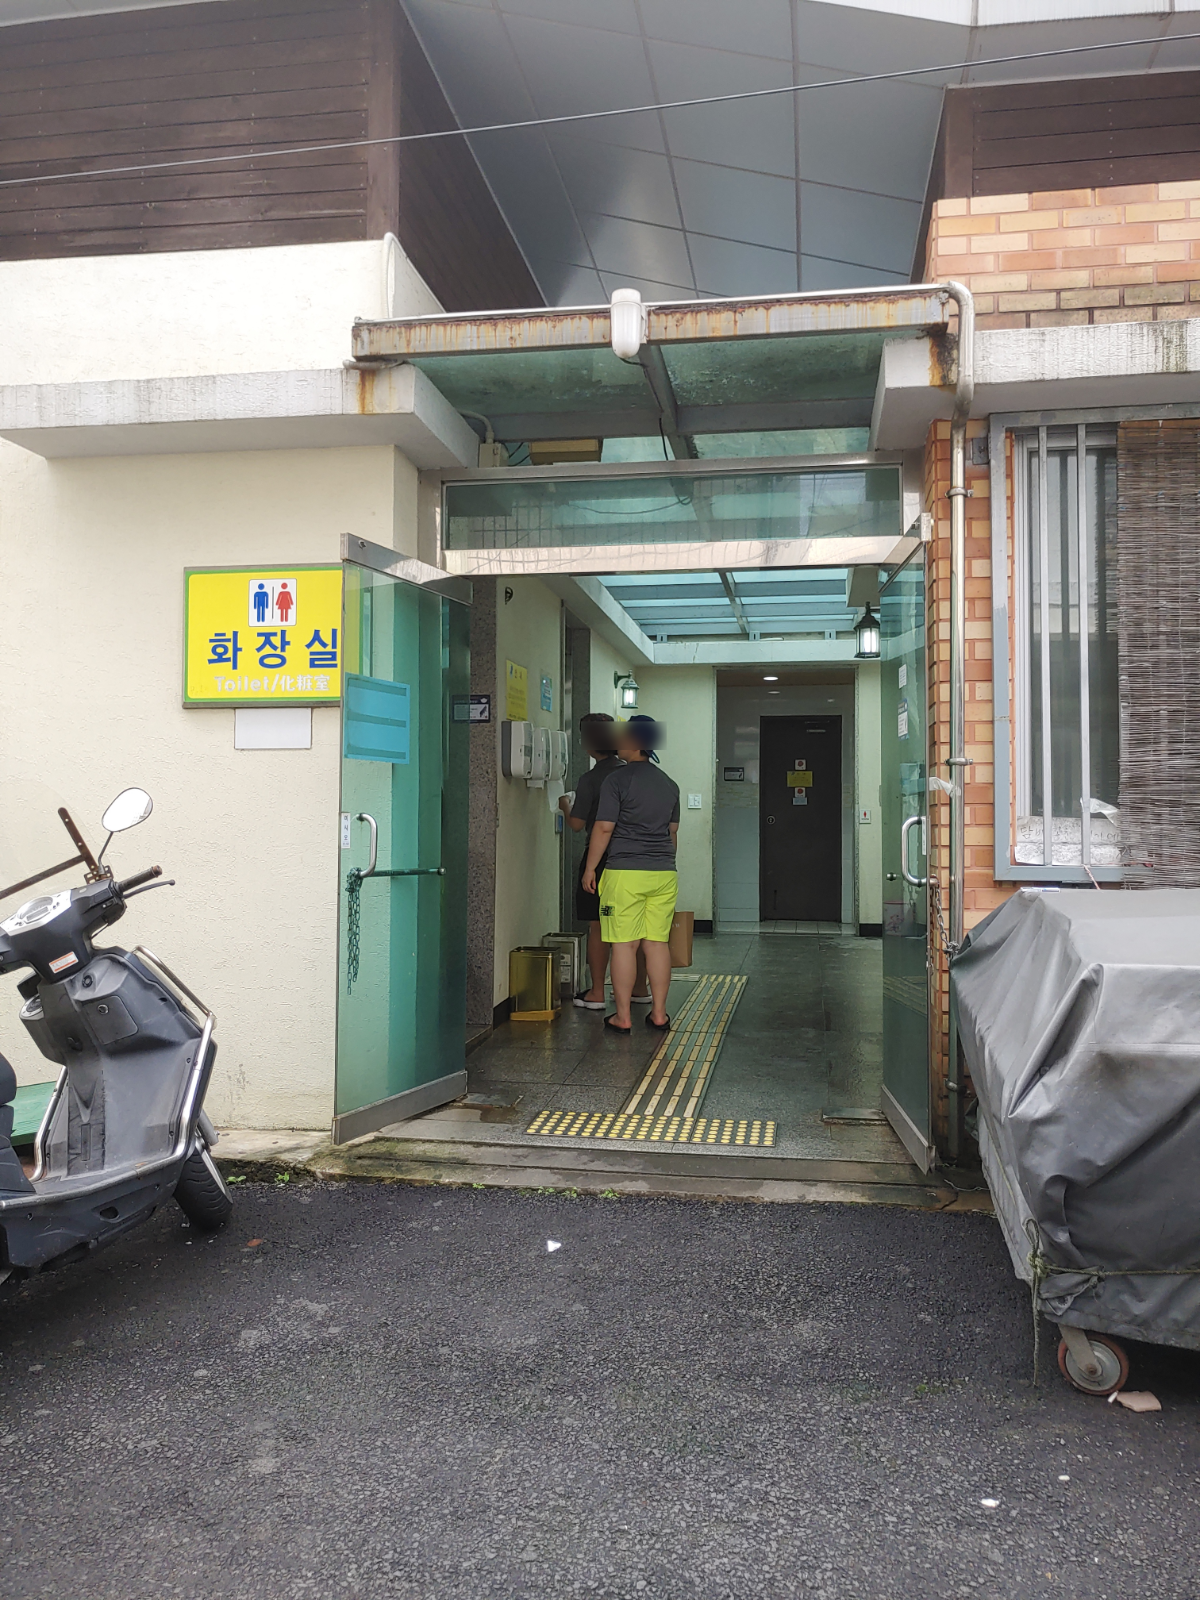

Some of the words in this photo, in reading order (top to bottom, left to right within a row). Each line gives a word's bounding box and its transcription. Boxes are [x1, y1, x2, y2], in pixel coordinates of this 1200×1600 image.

[207, 628, 338, 670] 화장실
[214, 673, 330, 693] Toilet/化粧室
